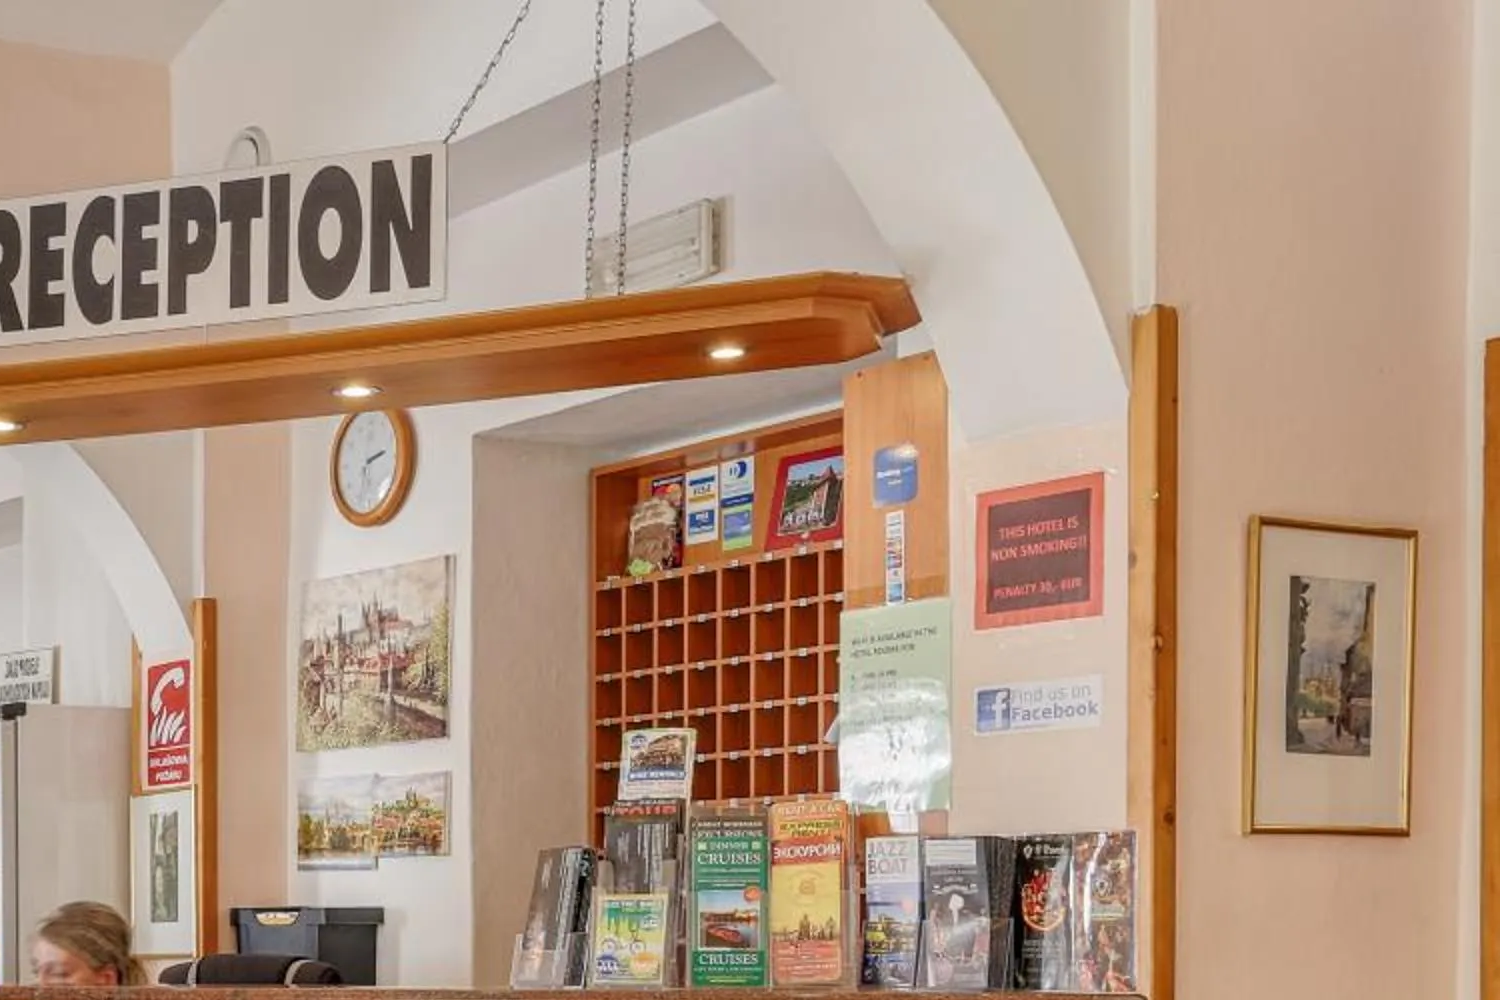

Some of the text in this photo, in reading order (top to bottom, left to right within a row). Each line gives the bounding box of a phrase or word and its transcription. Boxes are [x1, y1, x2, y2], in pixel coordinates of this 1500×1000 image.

[998, 515, 1079, 540] THIS HOTEL IS
[991, 546, 1018, 561] NON
[993, 582, 1037, 599] PENALTY
[1048, 688, 1068, 701] us
[1071, 685, 1092, 699] on
[1011, 700, 1100, 721] Facebook
[868, 840, 909, 858] JAZZ
[697, 852, 762, 865] CRUISES
[867, 858, 909, 875] BOAT
[699, 953, 759, 965] CRUISES
